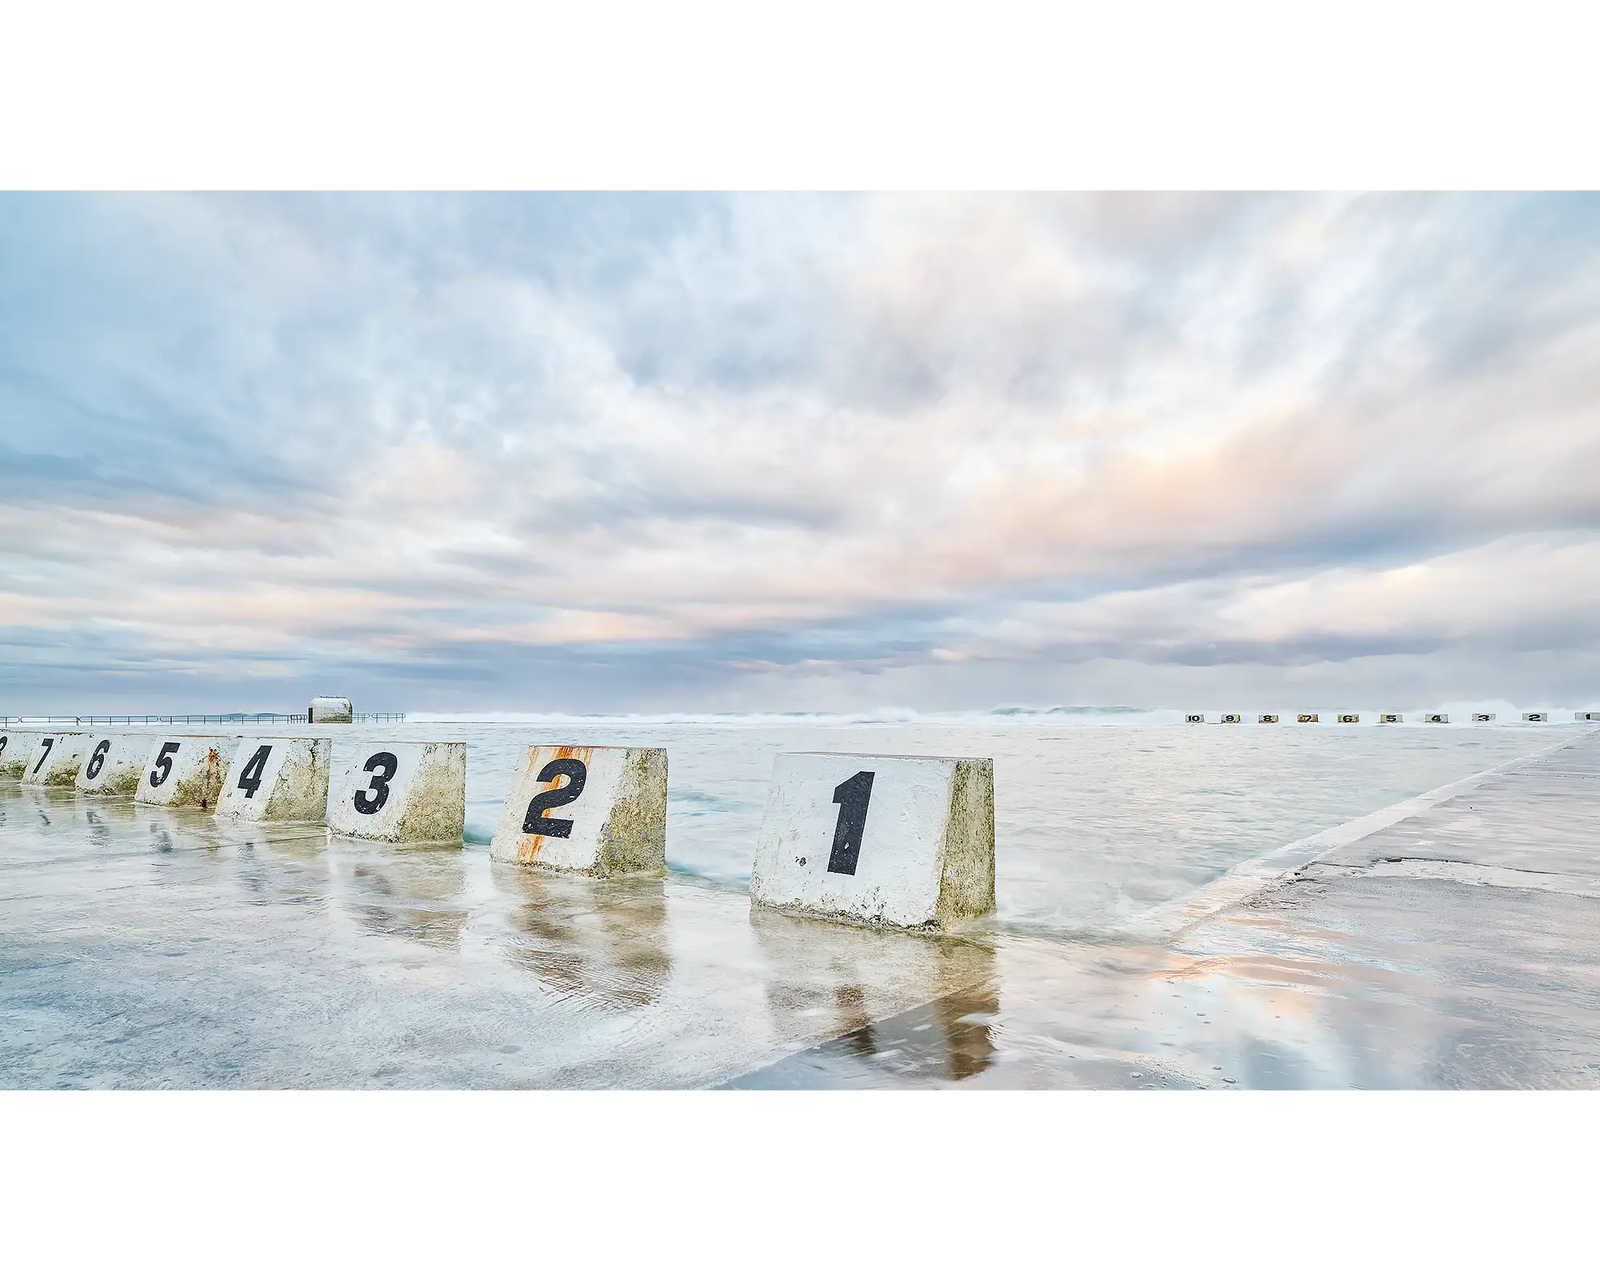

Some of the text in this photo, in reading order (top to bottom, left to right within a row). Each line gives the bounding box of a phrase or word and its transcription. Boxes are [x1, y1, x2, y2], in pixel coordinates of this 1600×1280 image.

[1342, 715, 1353, 723] 6
[1431, 714, 1442, 722] 4
[1478, 714, 1490, 722] 3
[1528, 714, 1541, 722] 2
[33, 738, 54, 774] 7
[86, 739, 110, 780] 6
[149, 742, 180, 787] 5
[237, 745, 272, 799] 4
[353, 752, 398, 815] 3
[522, 758, 587, 839] 2
[827, 770, 875, 876] 1
